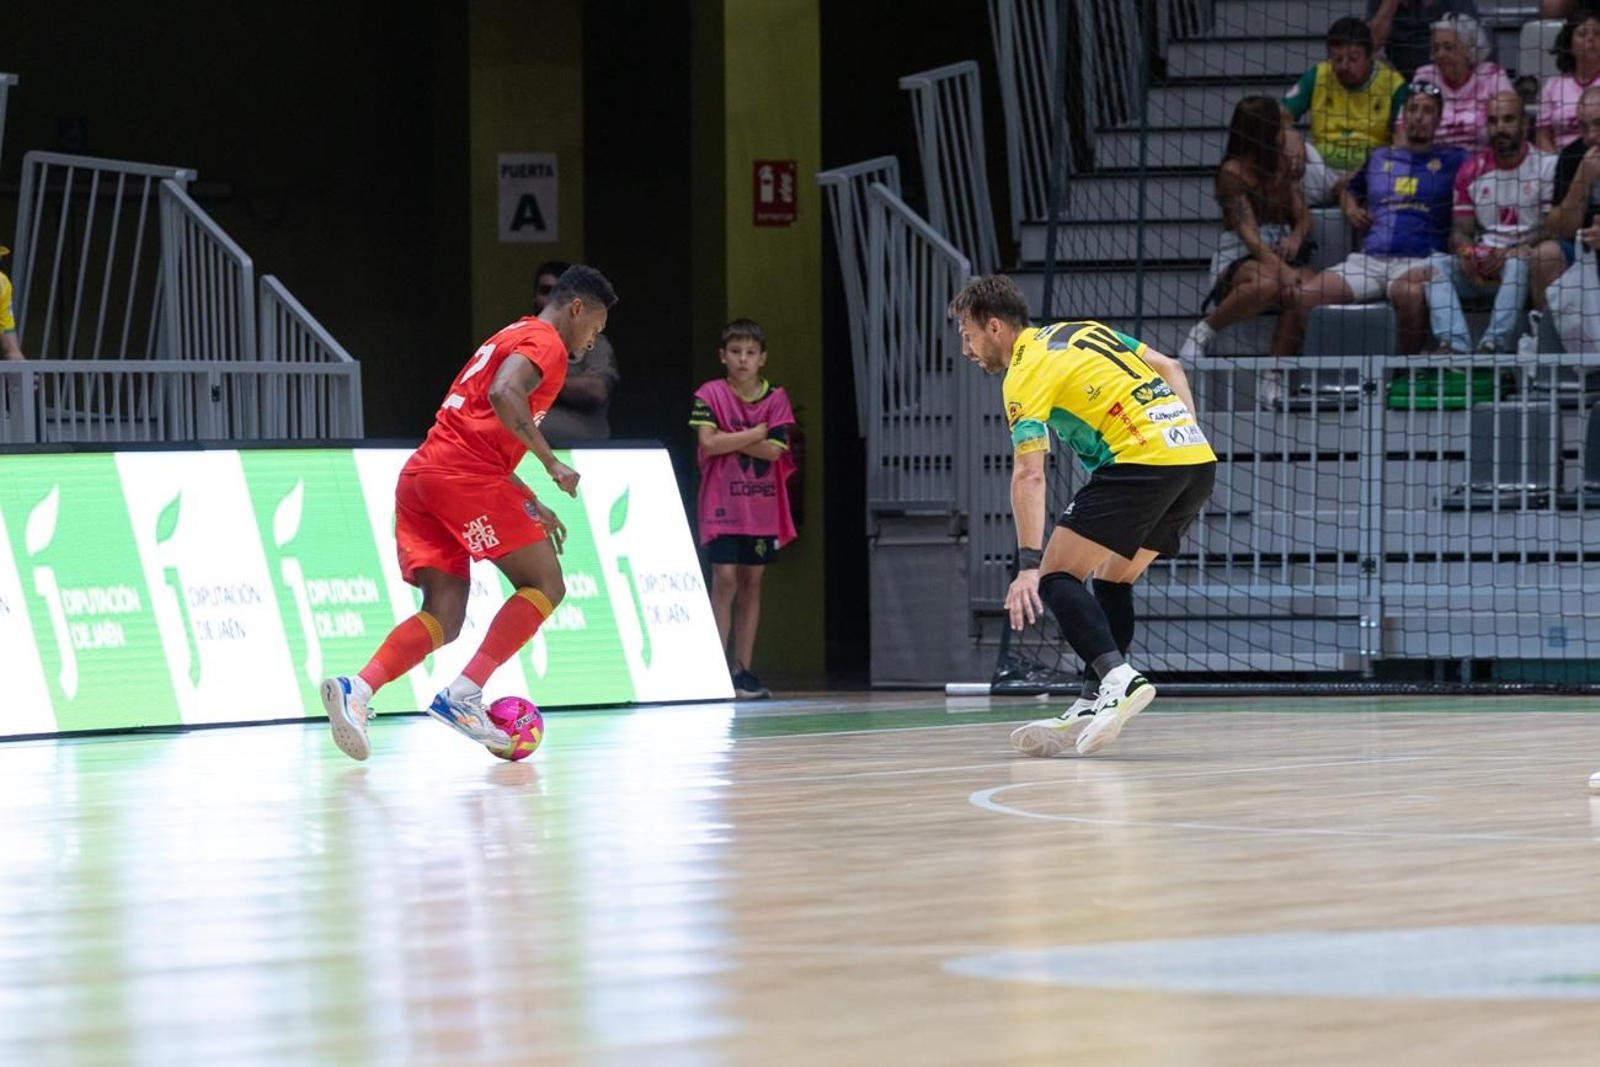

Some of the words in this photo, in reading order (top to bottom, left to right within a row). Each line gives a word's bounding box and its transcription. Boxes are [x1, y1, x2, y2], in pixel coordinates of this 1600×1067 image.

[501, 163, 555, 178] PUERTA
[509, 193, 547, 232] A
[730, 481, 776, 497] COPE
